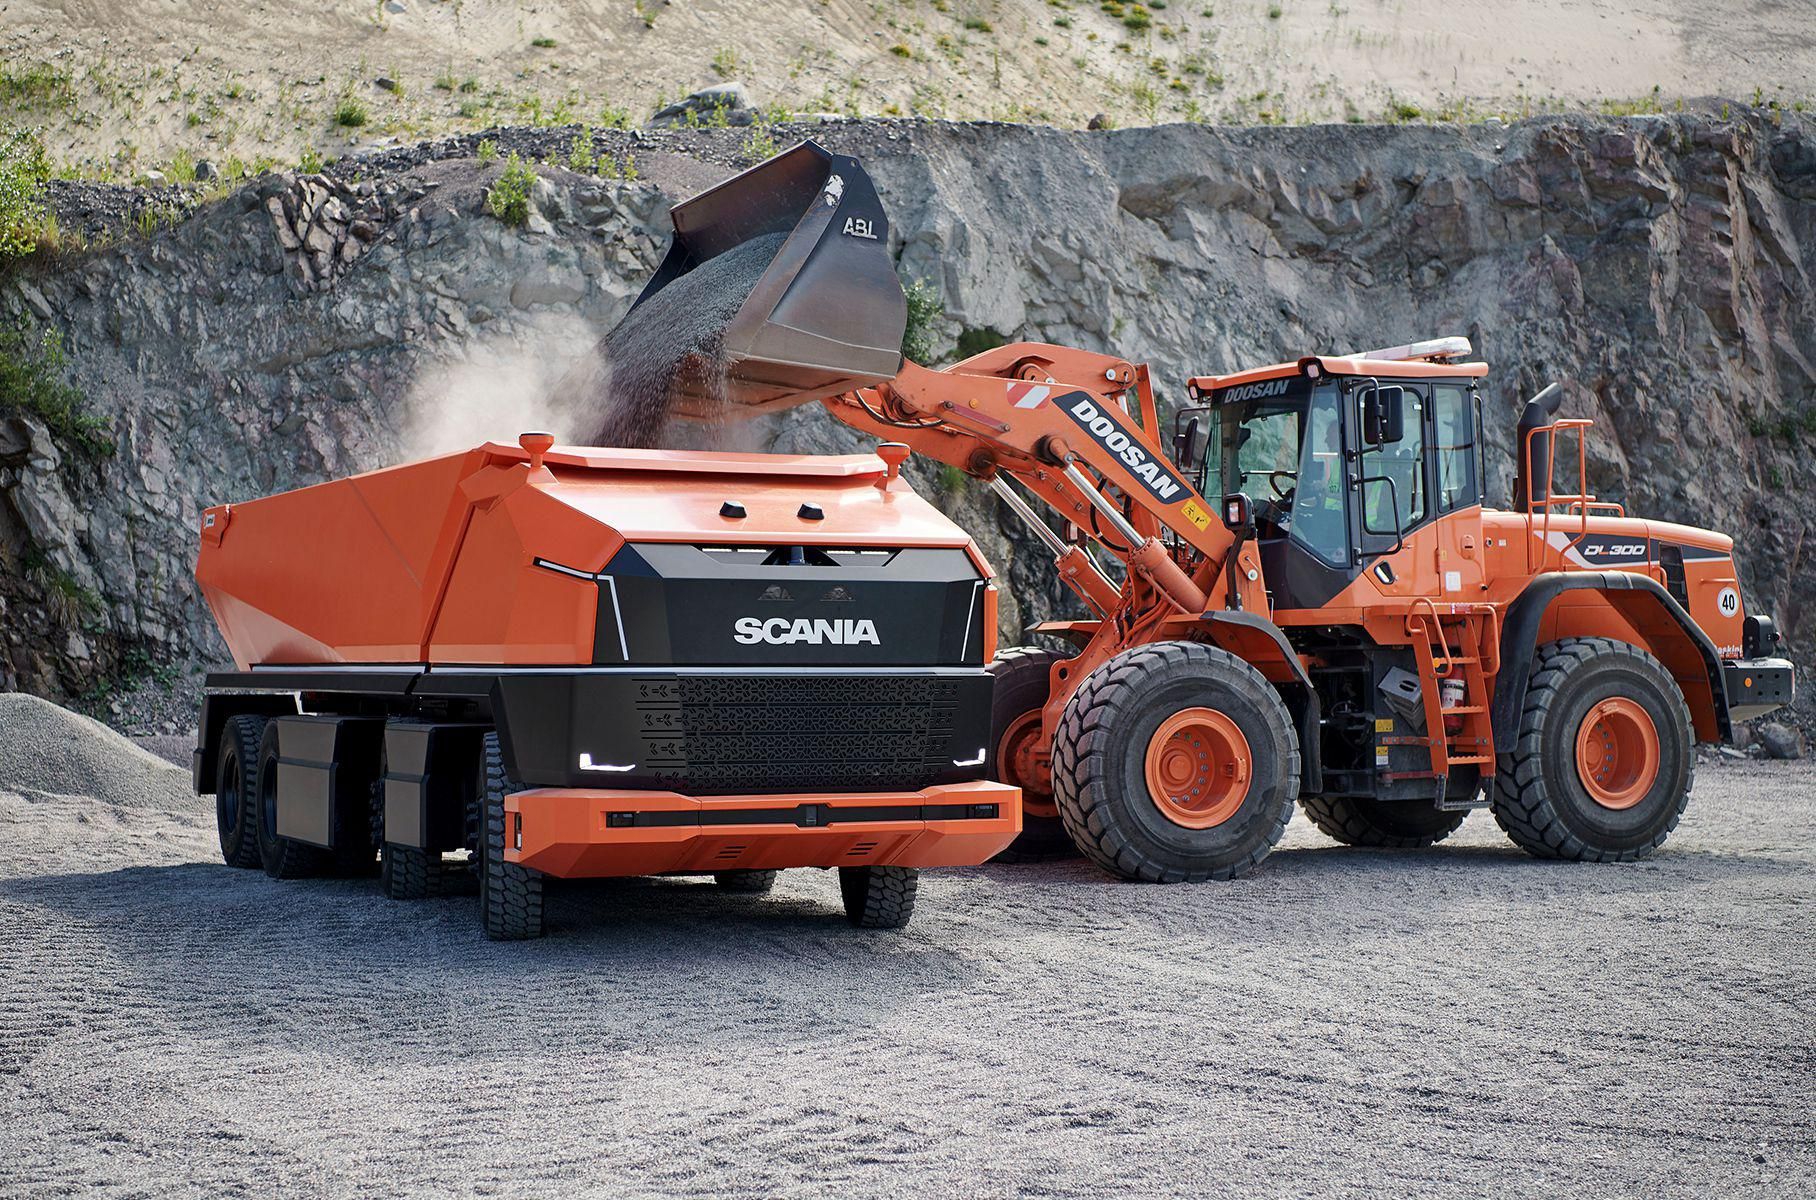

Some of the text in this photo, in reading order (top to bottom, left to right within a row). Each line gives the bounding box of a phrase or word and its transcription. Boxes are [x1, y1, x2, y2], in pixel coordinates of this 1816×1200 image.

[843, 217, 878, 239] ABL
[1223, 379, 1290, 404] DOOSAN
[1070, 399, 1181, 500] DOOSAN
[1584, 544, 1646, 556] DL300
[1722, 594, 1735, 610] 40
[733, 617, 881, 645] SCANIA
